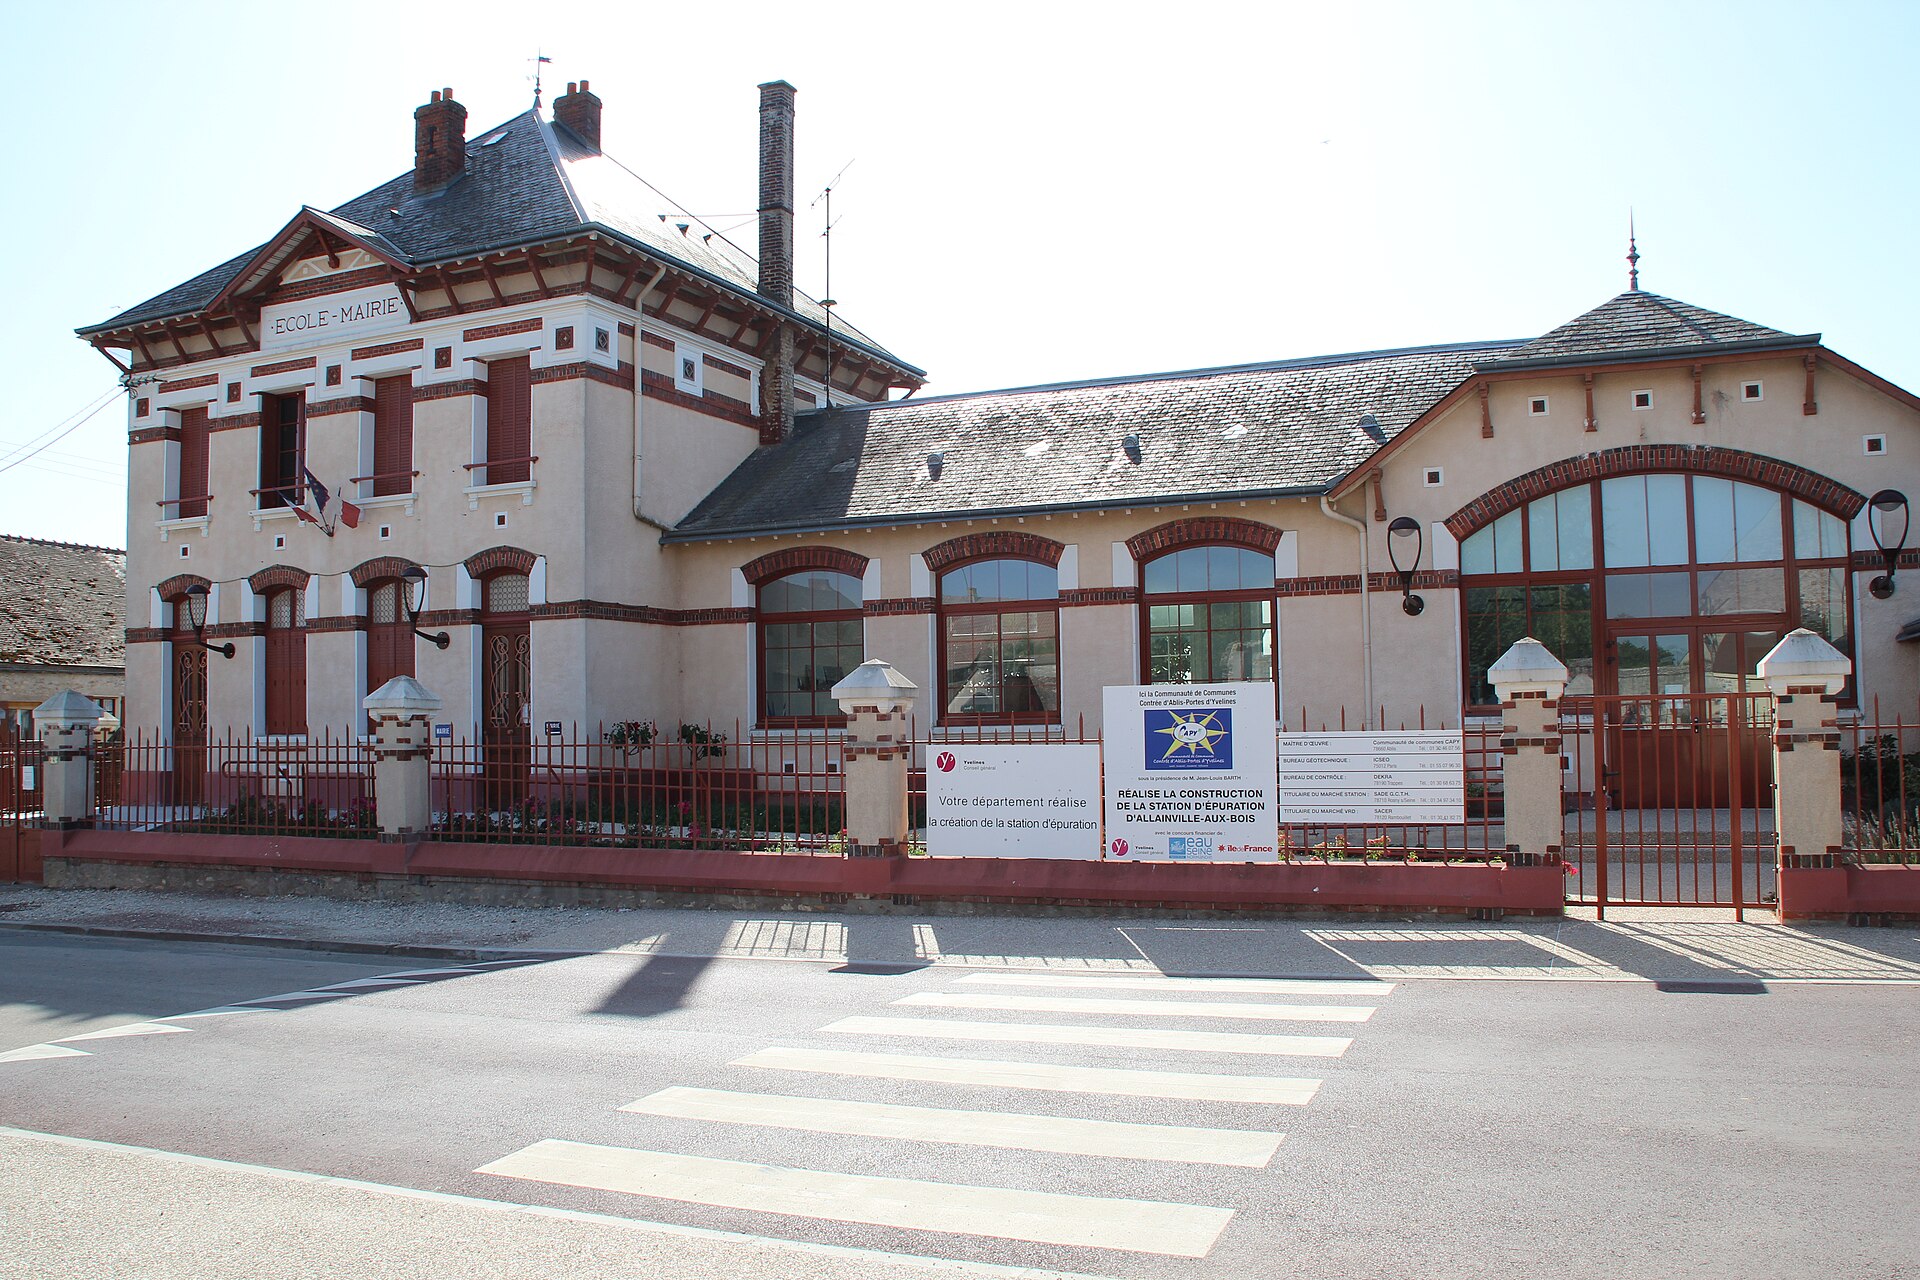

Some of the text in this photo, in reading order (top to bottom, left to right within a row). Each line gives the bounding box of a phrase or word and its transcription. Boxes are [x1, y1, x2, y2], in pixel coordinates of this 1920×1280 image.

[1139, 699, 1162, 707] Contrée
[1163, 698, 1204, 706] d'Ablis-Portes
[1179, 725, 1198, 738] CAPY
[1118, 788, 1263, 798] RÉALISE LA CONSTRUCTION
[939, 796, 1087, 809] Votre département réalise
[1116, 800, 1265, 811] DE LA STATION D'ÉPURATION
[1126, 814, 1256, 823] D'ALLAINVILLE-AUX-BOIS
[928, 817, 1097, 831] la création de la station d'épuration
[1186, 837, 1212, 847] eau
